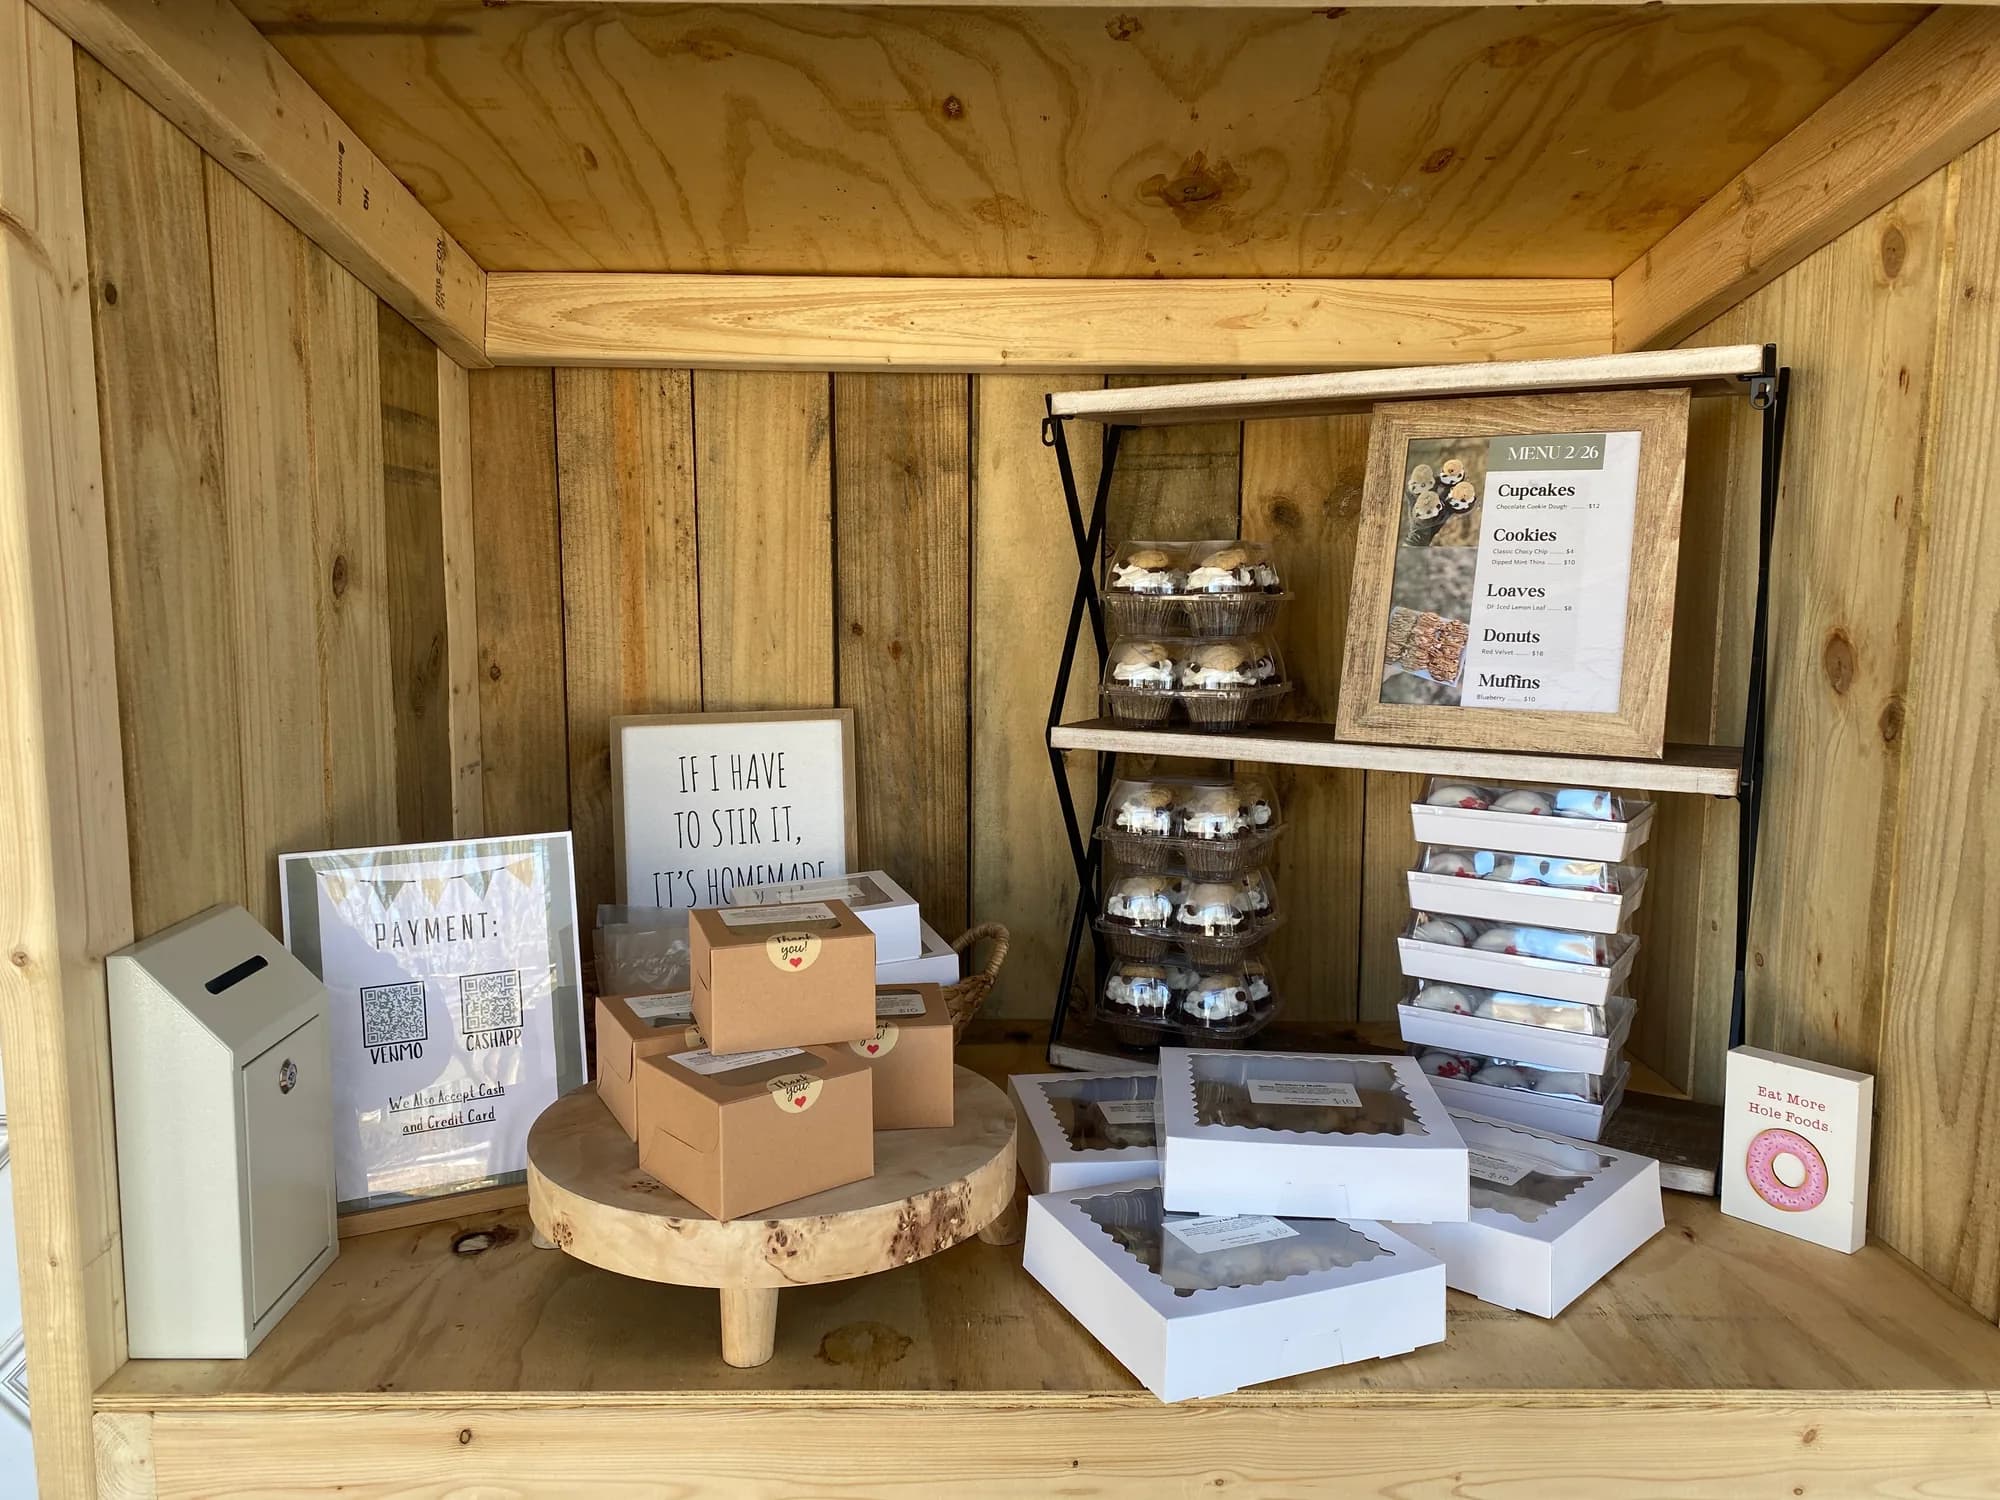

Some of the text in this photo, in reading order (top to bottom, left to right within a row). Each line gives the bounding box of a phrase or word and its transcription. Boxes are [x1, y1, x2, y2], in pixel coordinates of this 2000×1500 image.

[1507, 446, 1560, 460] MENU
[1498, 482, 1576, 500] Cupcakes
[1493, 528, 1557, 542] Cookies
[1487, 583, 1546, 598] Loaves
[1483, 628, 1541, 643] Donuts
[1478, 673, 1541, 690] Muffins
[1476, 694, 1506, 702] Blueberry
[678, 752, 787, 793] IF I HAVE
[673, 805, 801, 849] TO STIR IT,
[653, 869, 697, 908] IT'S
[375, 912, 498, 950] PAYMENT:
[775, 933, 811, 944] Thank
[781, 941, 808, 961] you!
[466, 1029, 522, 1052] CASHAPP
[370, 1042, 423, 1065] VENMO
[772, 1073, 808, 1090] Thank
[389, 1080, 505, 1110] We Also Accept Cash
[1757, 1085, 1826, 1112] Eat More
[402, 1105, 495, 1133] and Credit Card
[1748, 1102, 1782, 1119] Hole
